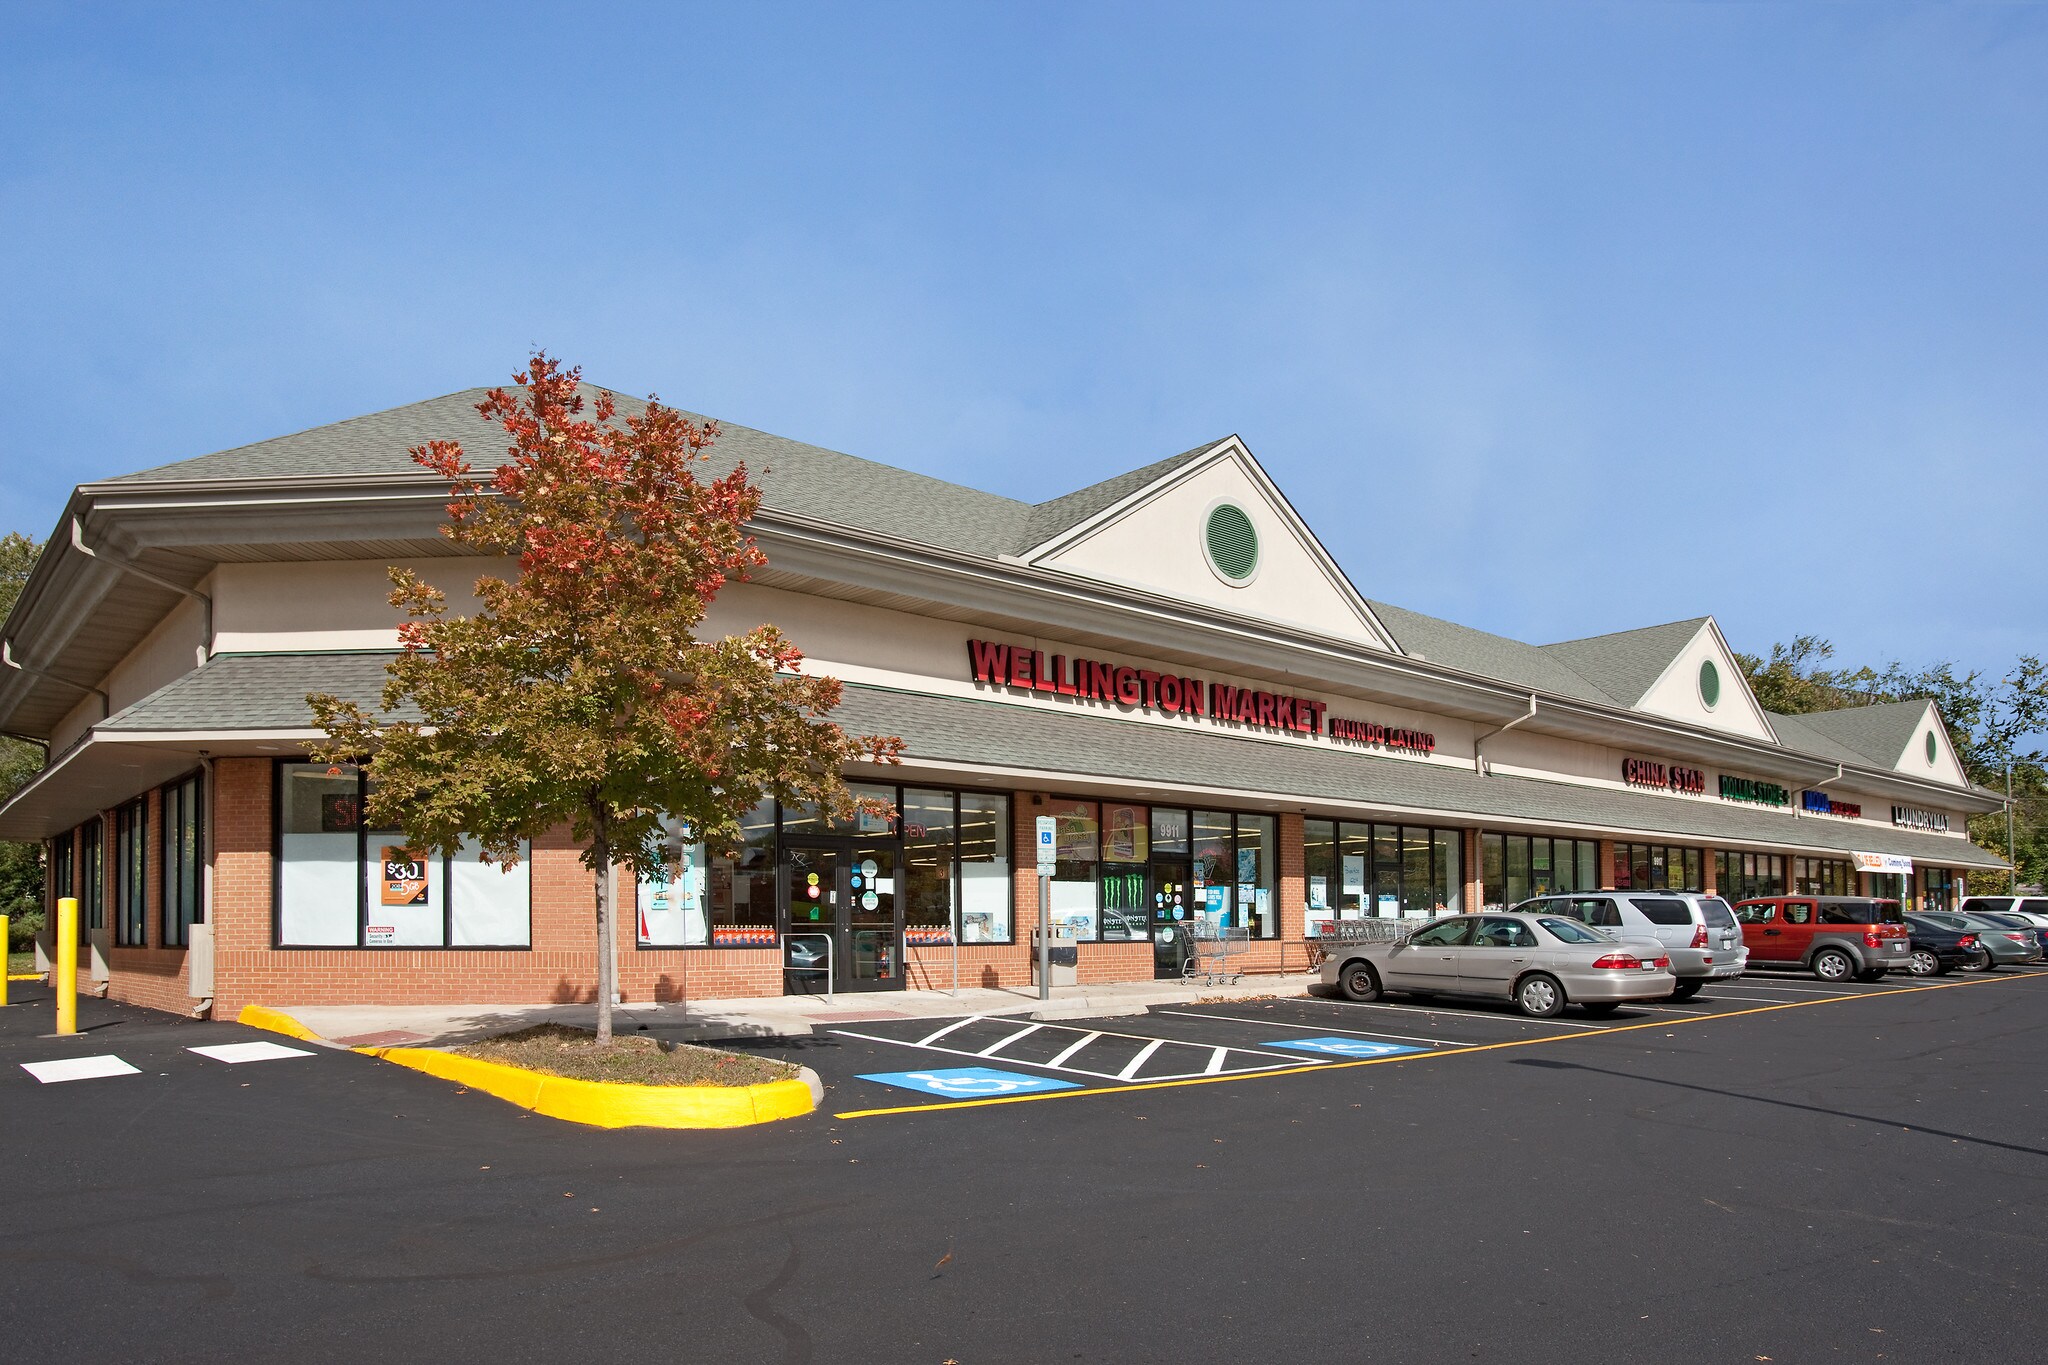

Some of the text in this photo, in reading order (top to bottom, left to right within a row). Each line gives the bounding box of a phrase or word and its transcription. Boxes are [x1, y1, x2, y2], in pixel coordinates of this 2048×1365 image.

[967, 639, 1326, 735] WELLINGTON MARKET
[1329, 718, 1435, 751] MUNDO LATINO
[1622, 758, 1705, 792] CHINA STAR
[1719, 775, 1756, 801] DOLLAR
[1755, 781, 1783, 806] STORE
[1160, 823, 1179, 838] 9911
[1891, 806, 1950, 831] LAUNDRYMAT
